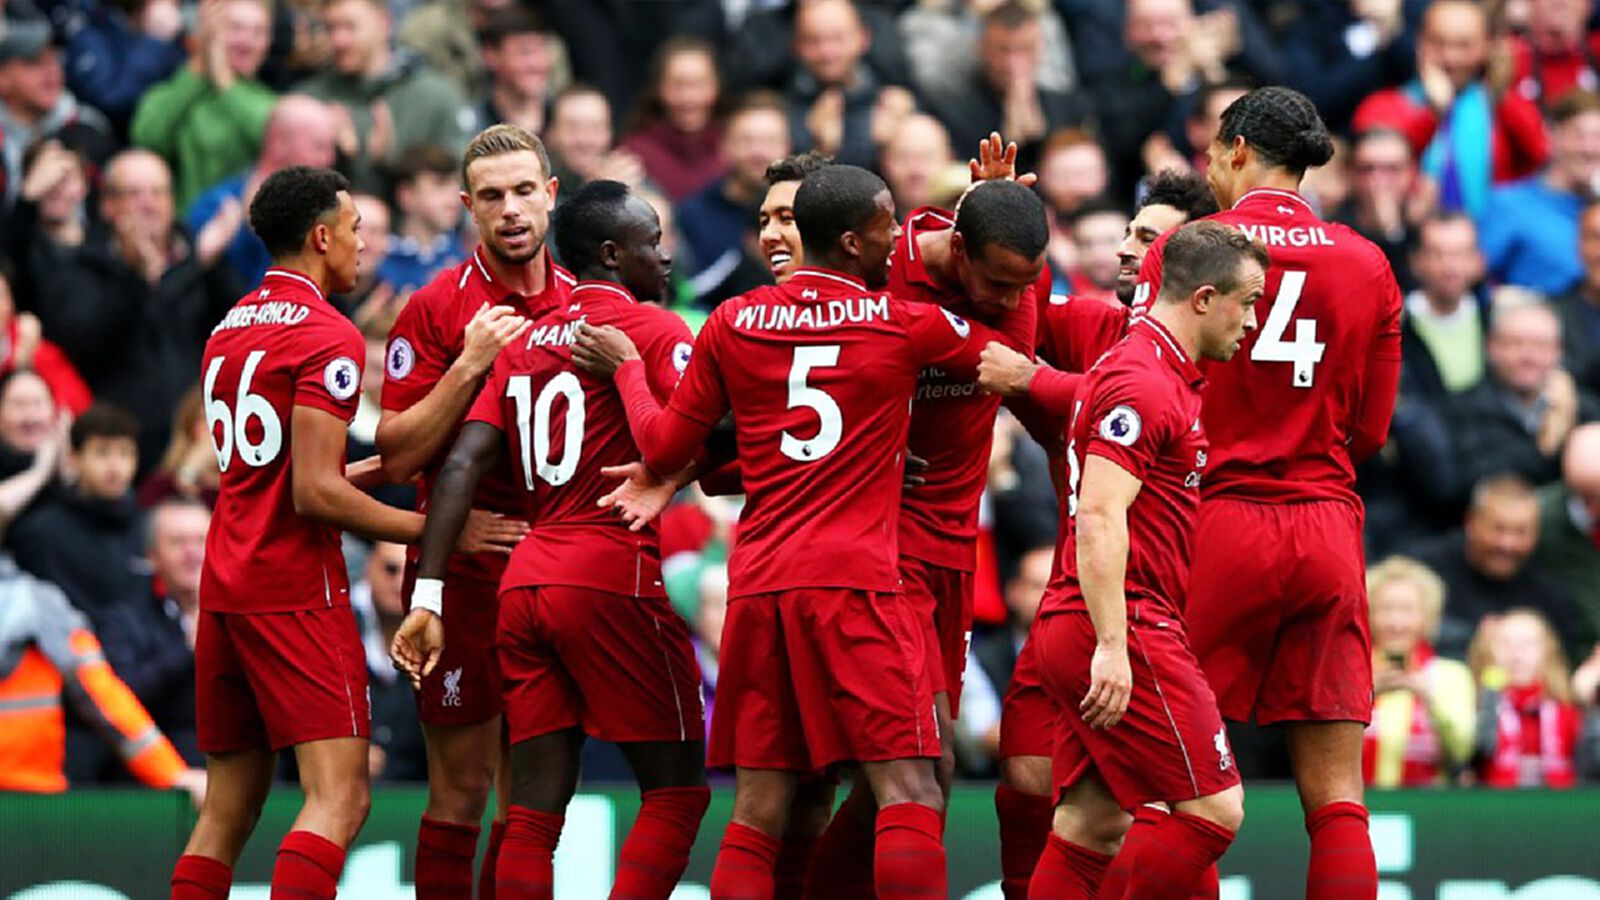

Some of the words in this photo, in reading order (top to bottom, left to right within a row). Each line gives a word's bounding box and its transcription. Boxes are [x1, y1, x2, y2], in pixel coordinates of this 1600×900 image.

[1238, 223, 1336, 247] VIRGIL
[734, 296, 889, 331] WIJNALDUM
[1250, 270, 1326, 388] 4
[203, 350, 283, 473] 66
[506, 371, 586, 491] 10
[780, 345, 844, 462] 5
[917, 382, 976, 400] rtered
